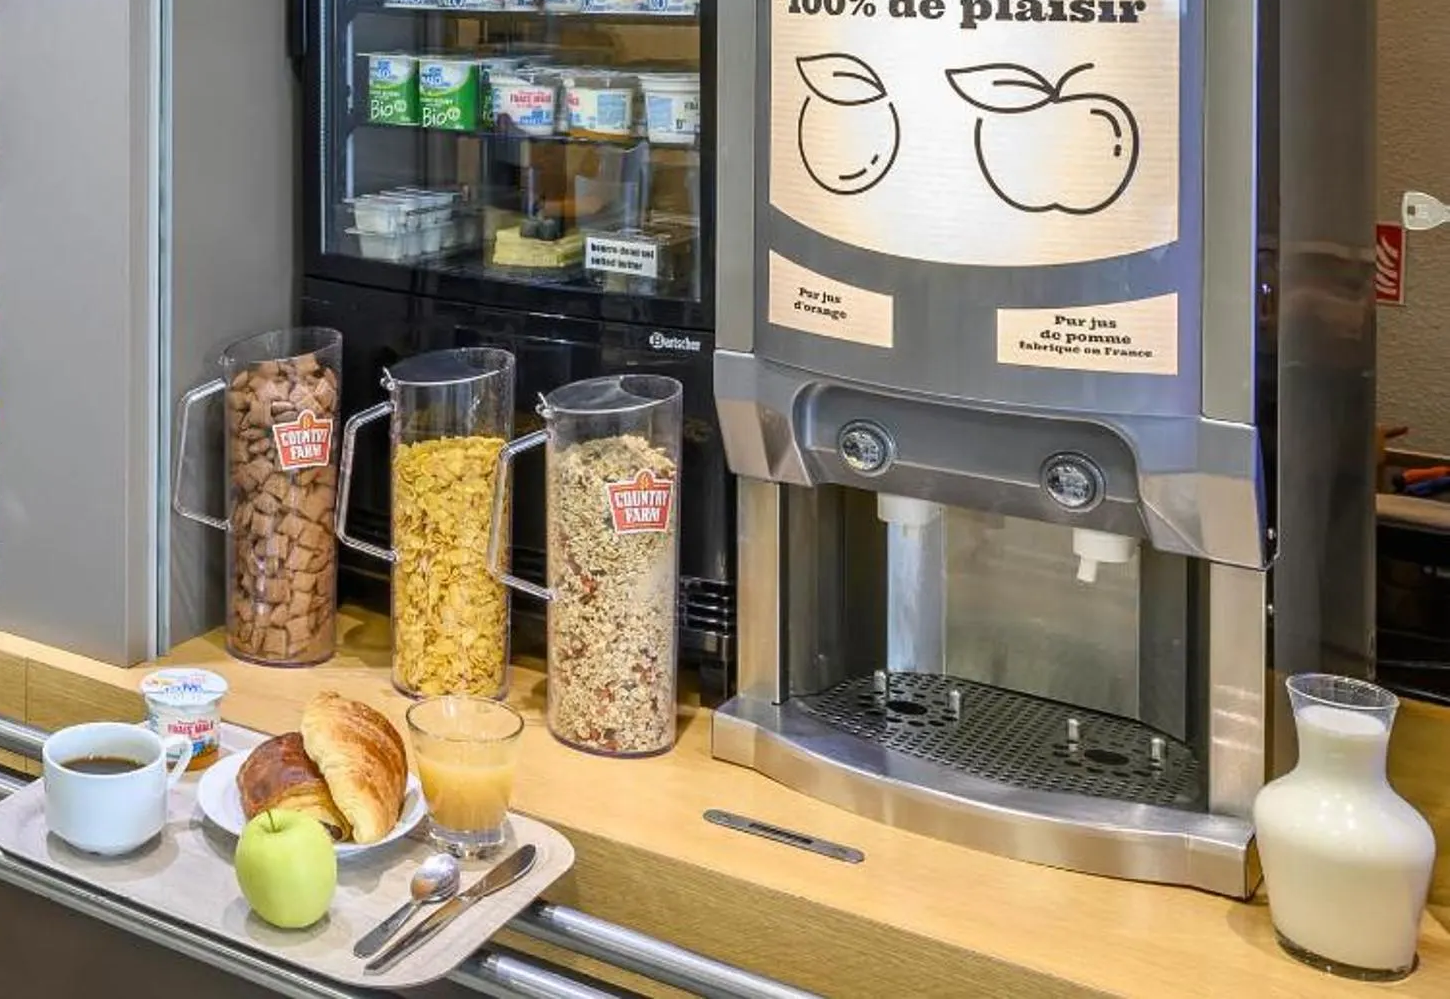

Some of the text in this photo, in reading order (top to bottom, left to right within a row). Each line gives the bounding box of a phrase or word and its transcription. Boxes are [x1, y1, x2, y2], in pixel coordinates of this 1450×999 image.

[371, 100, 394, 120] Bio
[422, 107, 446, 128] Bio
[798, 287, 842, 304] Pur jus
[794, 301, 848, 320] d'orange
[1054, 315, 1117, 331] Pur jus
[1040, 330, 1132, 345] de pomme
[1084, 347, 1101, 355] en
[1104, 347, 1153, 358] France
[290, 443, 323, 461] FARM
[614, 489, 668, 509] COUNTRY
[625, 506, 661, 523] FARM
